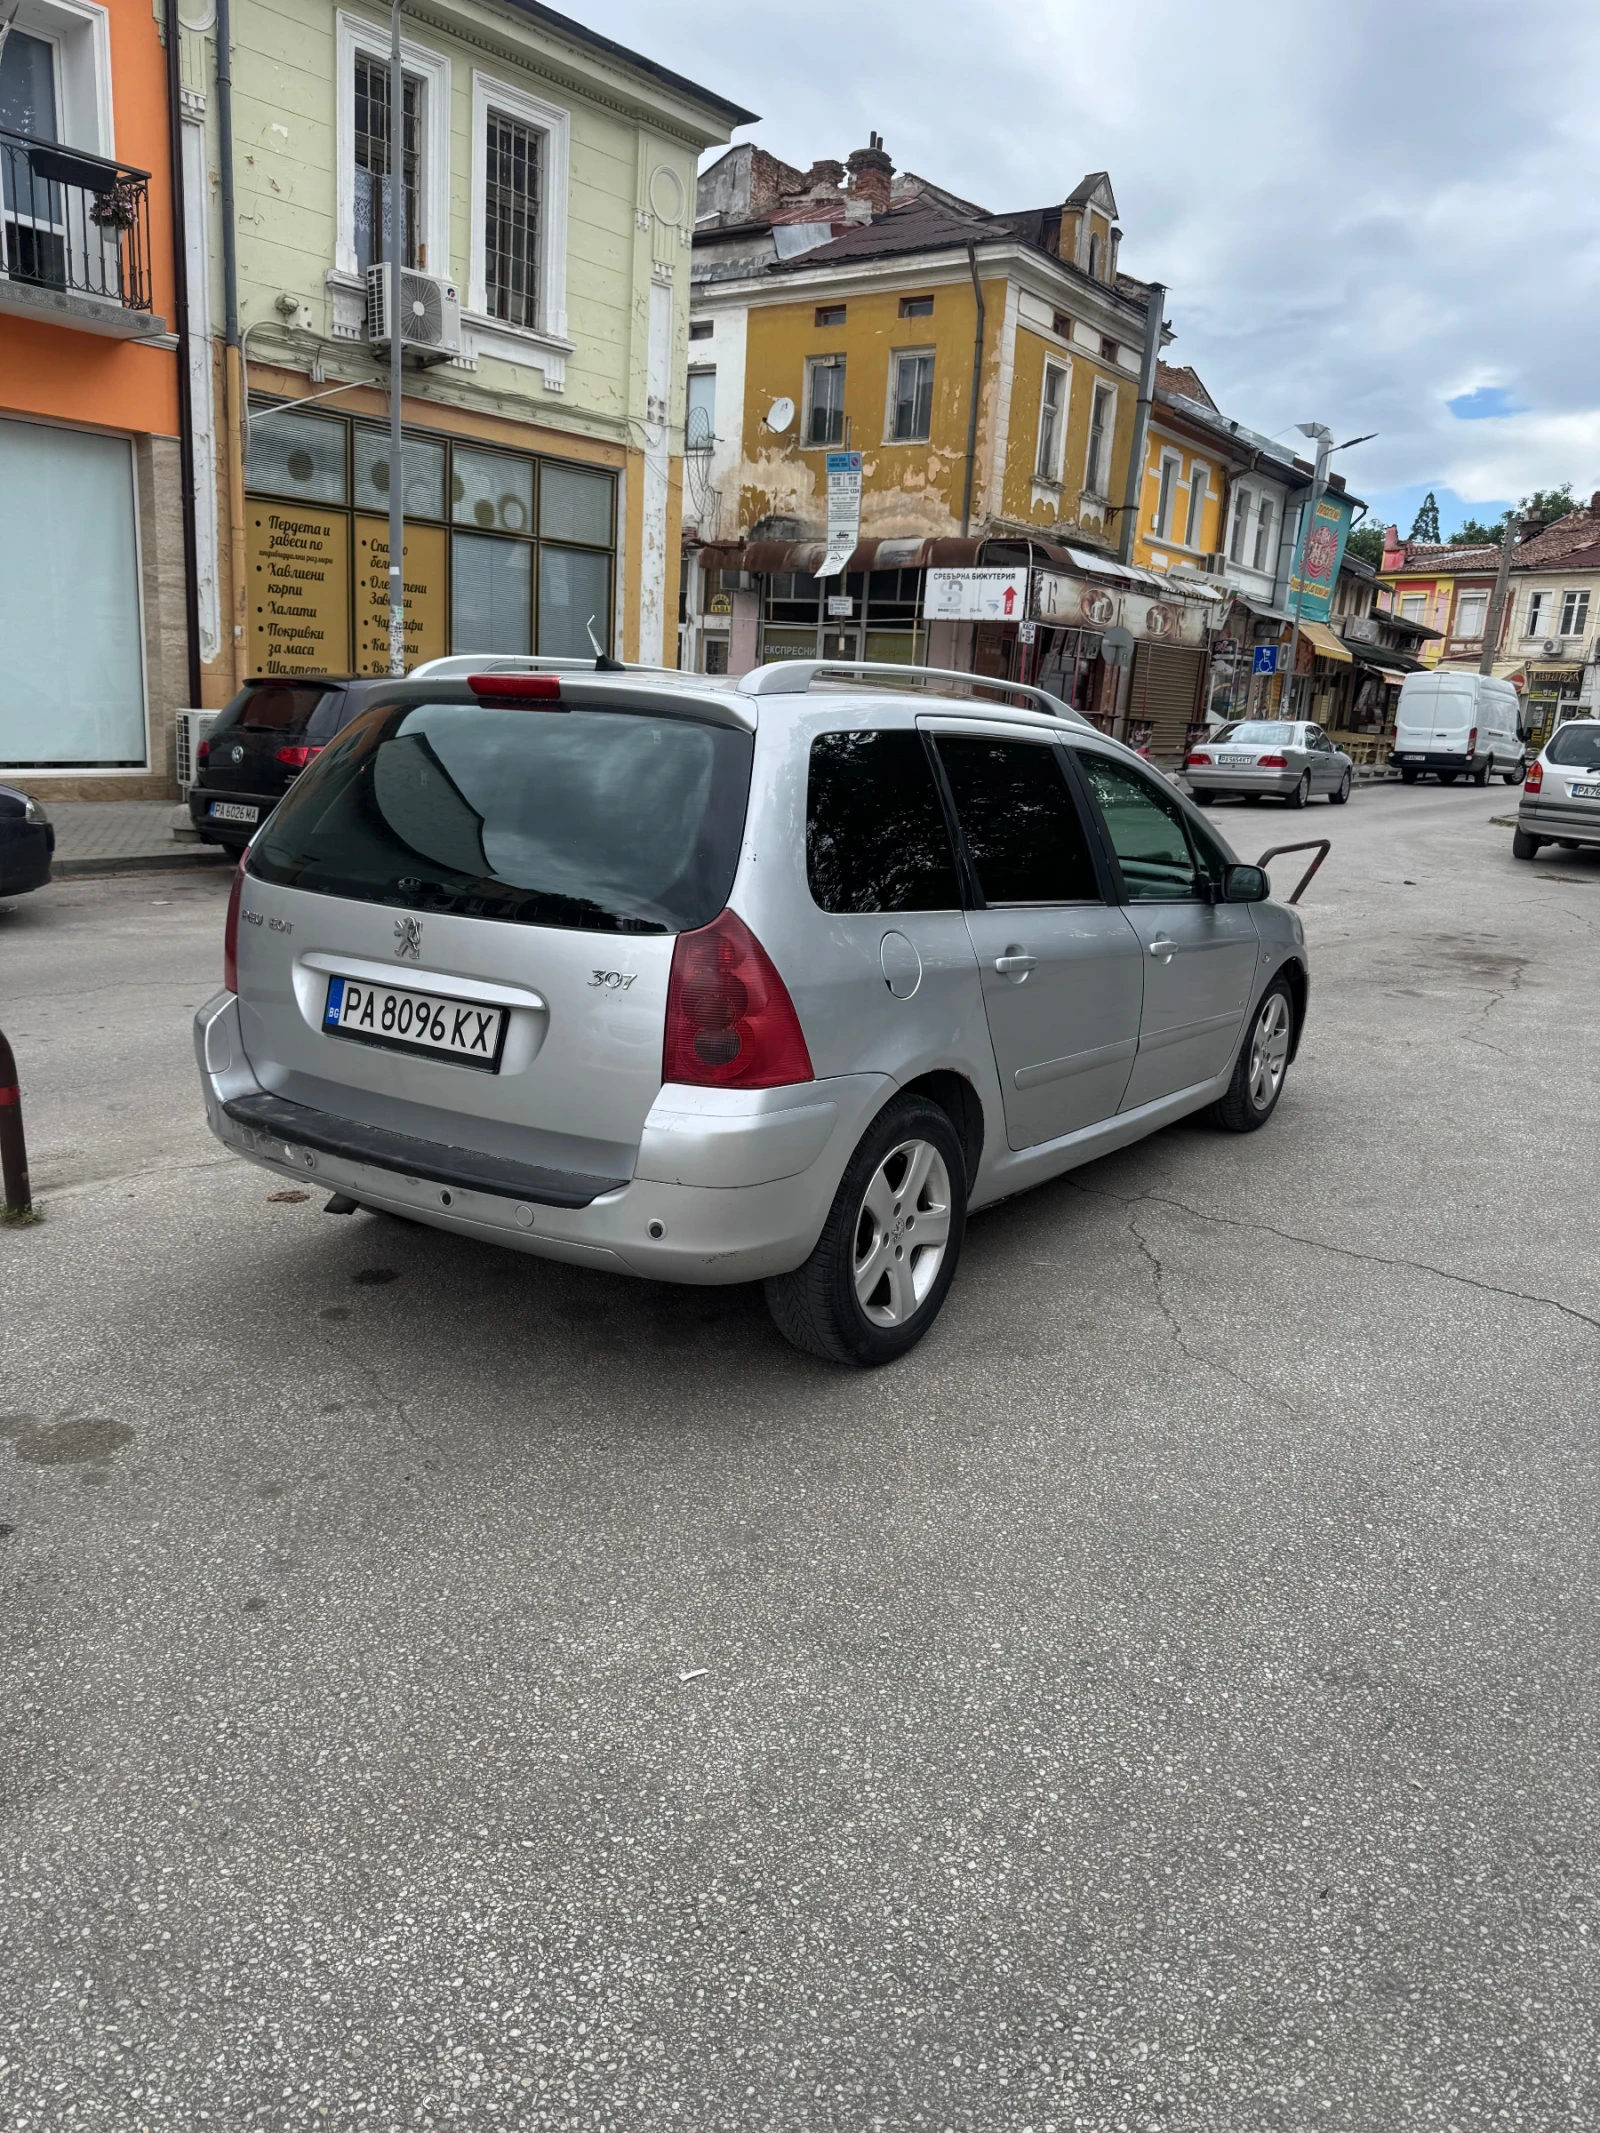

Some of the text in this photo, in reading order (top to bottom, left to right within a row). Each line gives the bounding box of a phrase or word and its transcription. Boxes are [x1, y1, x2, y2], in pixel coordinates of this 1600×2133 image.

[268, 515, 331, 537] Пердета и
[269, 534, 323, 551] завеси по
[267, 562, 325, 582] Хавлиени
[933, 572, 1016, 580] СРЕБЪРНА БИЖУТЕРИЯ
[268, 583, 303, 598] кърпи
[267, 601, 317, 618] Халати
[267, 623, 324, 641] Покривки
[268, 643, 315, 657] за маса
[764, 644, 816, 657] ЕКСПРЕСНИ
[587, 968, 638, 991] 307
[328, 1007, 340, 1019] BG
